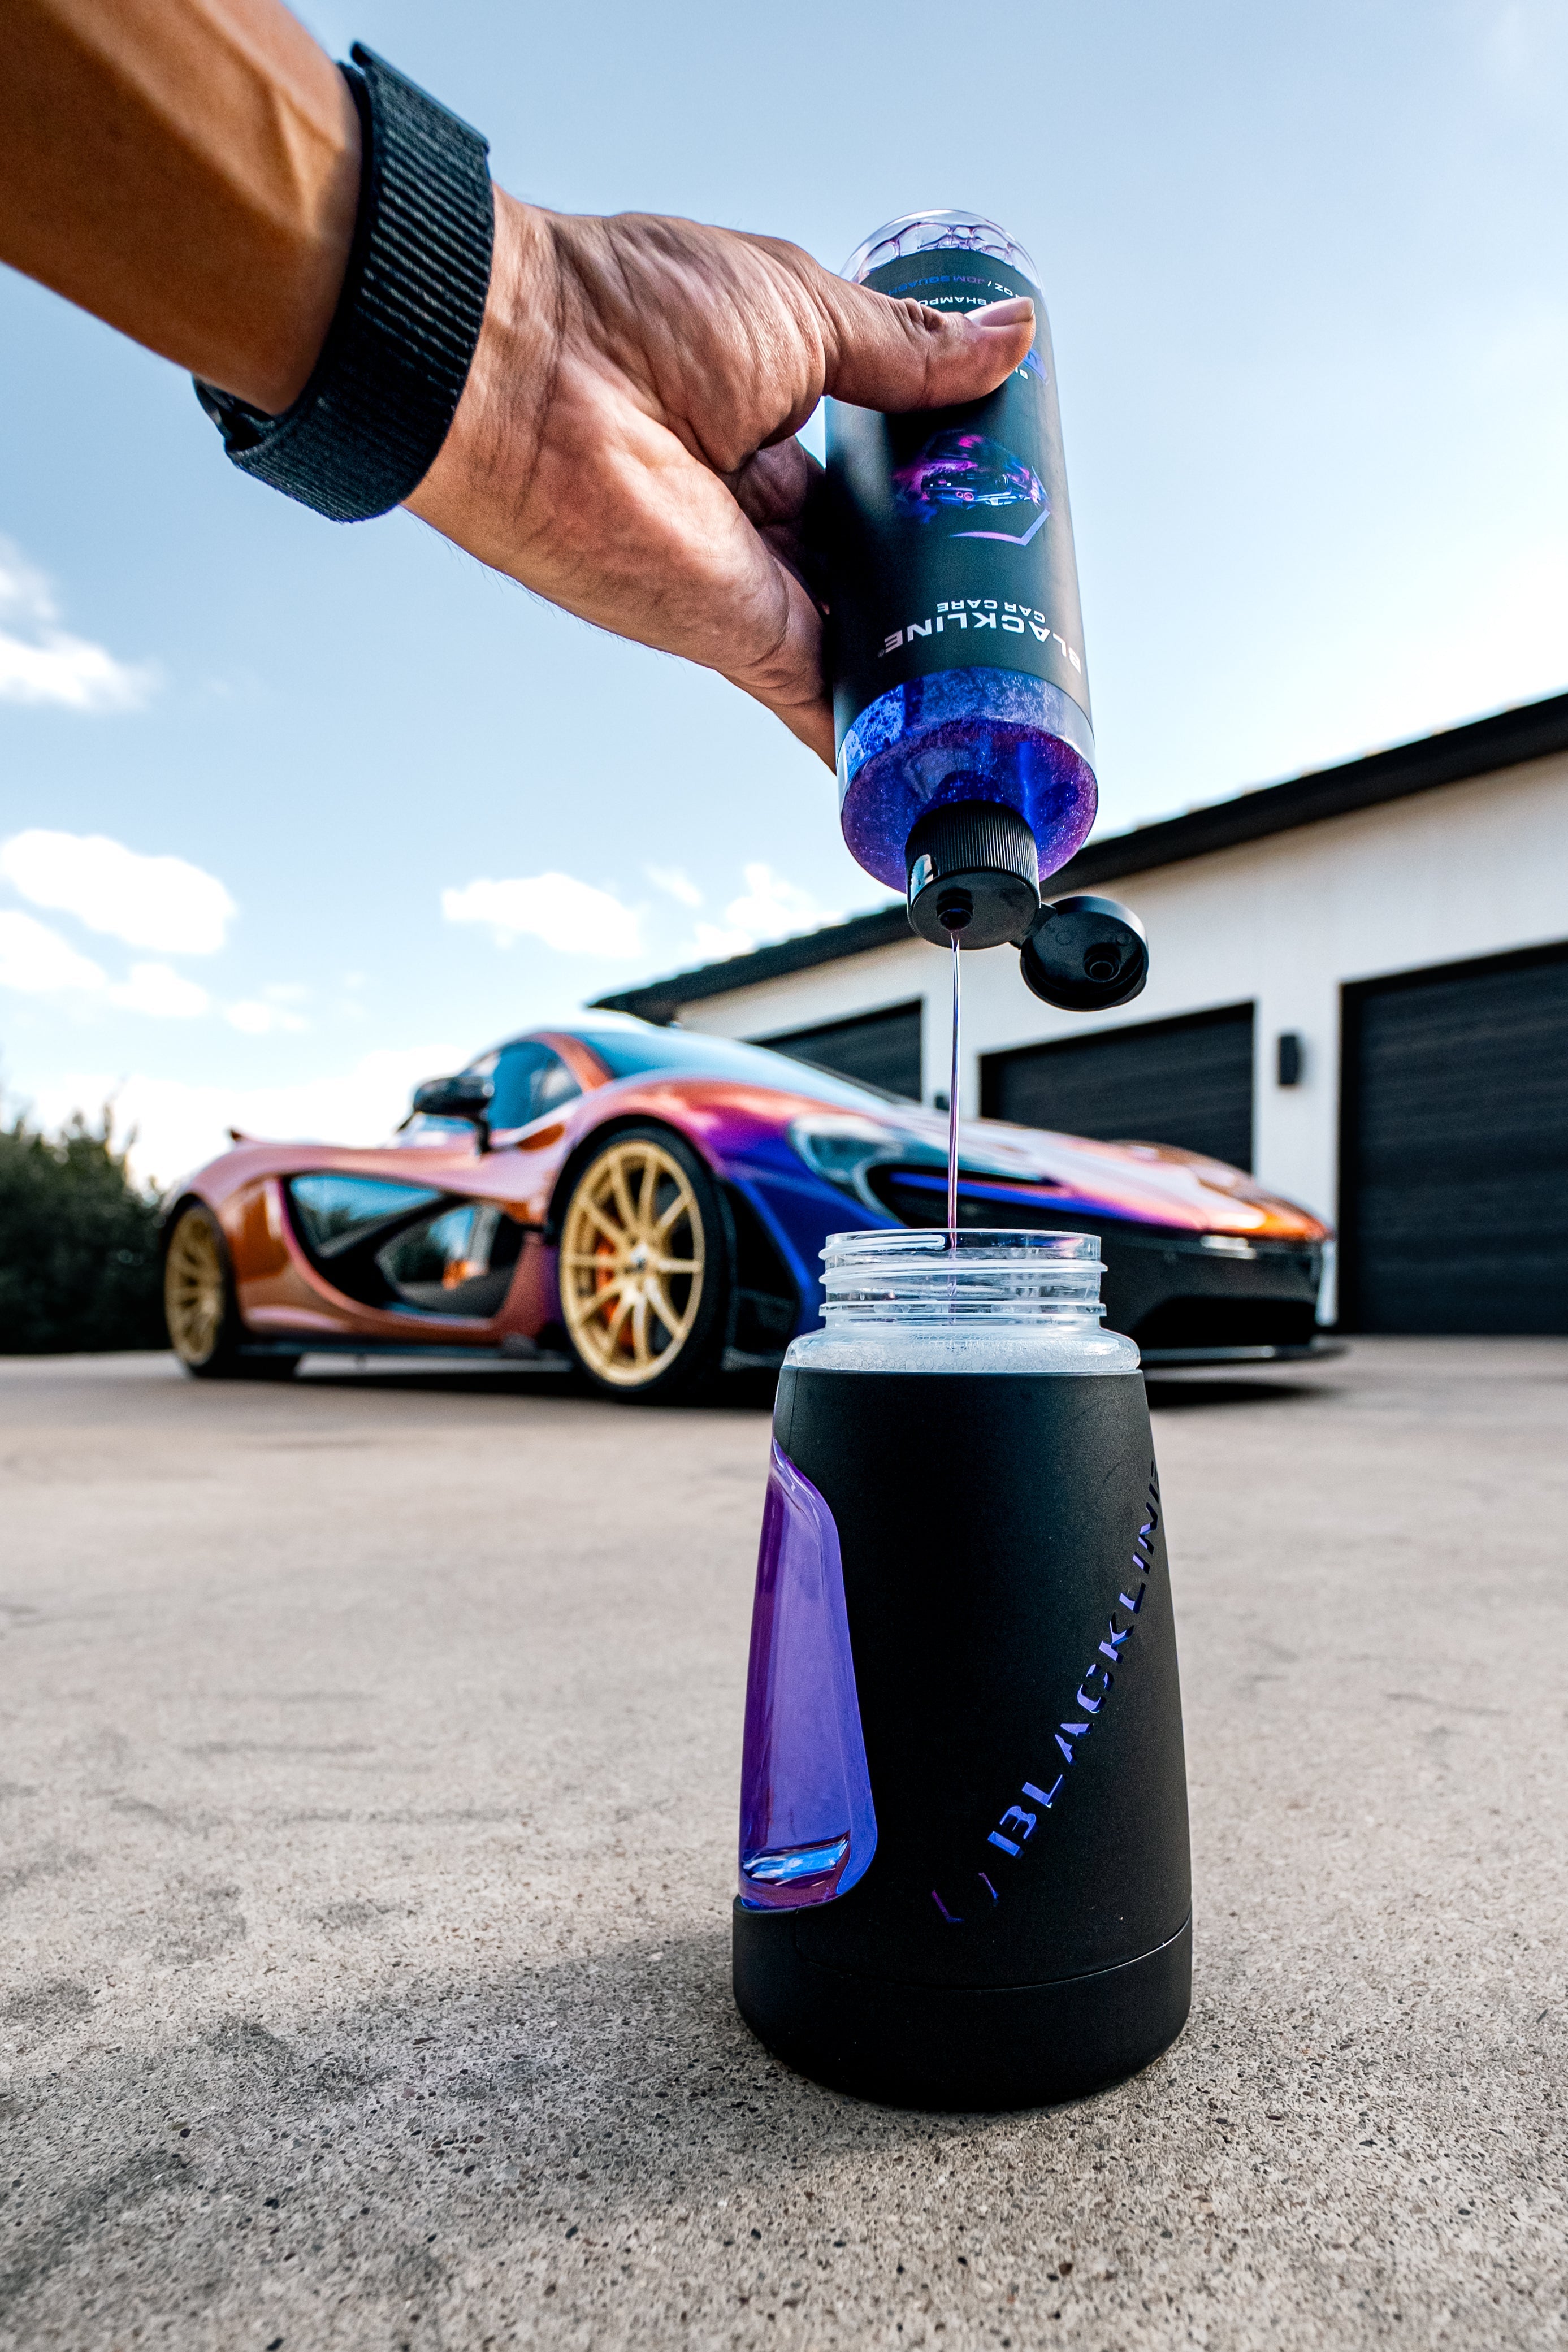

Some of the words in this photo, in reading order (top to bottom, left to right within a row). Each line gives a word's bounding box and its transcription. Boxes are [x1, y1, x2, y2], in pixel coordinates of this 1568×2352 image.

[888, 275, 950, 296] SQUASH
[953, 275, 985, 284] JDM
[994, 283, 1013, 297] OZ
[917, 296, 987, 306] SHAMPO
[936, 599, 998, 614] CARE
[1004, 601, 1046, 622] CAR
